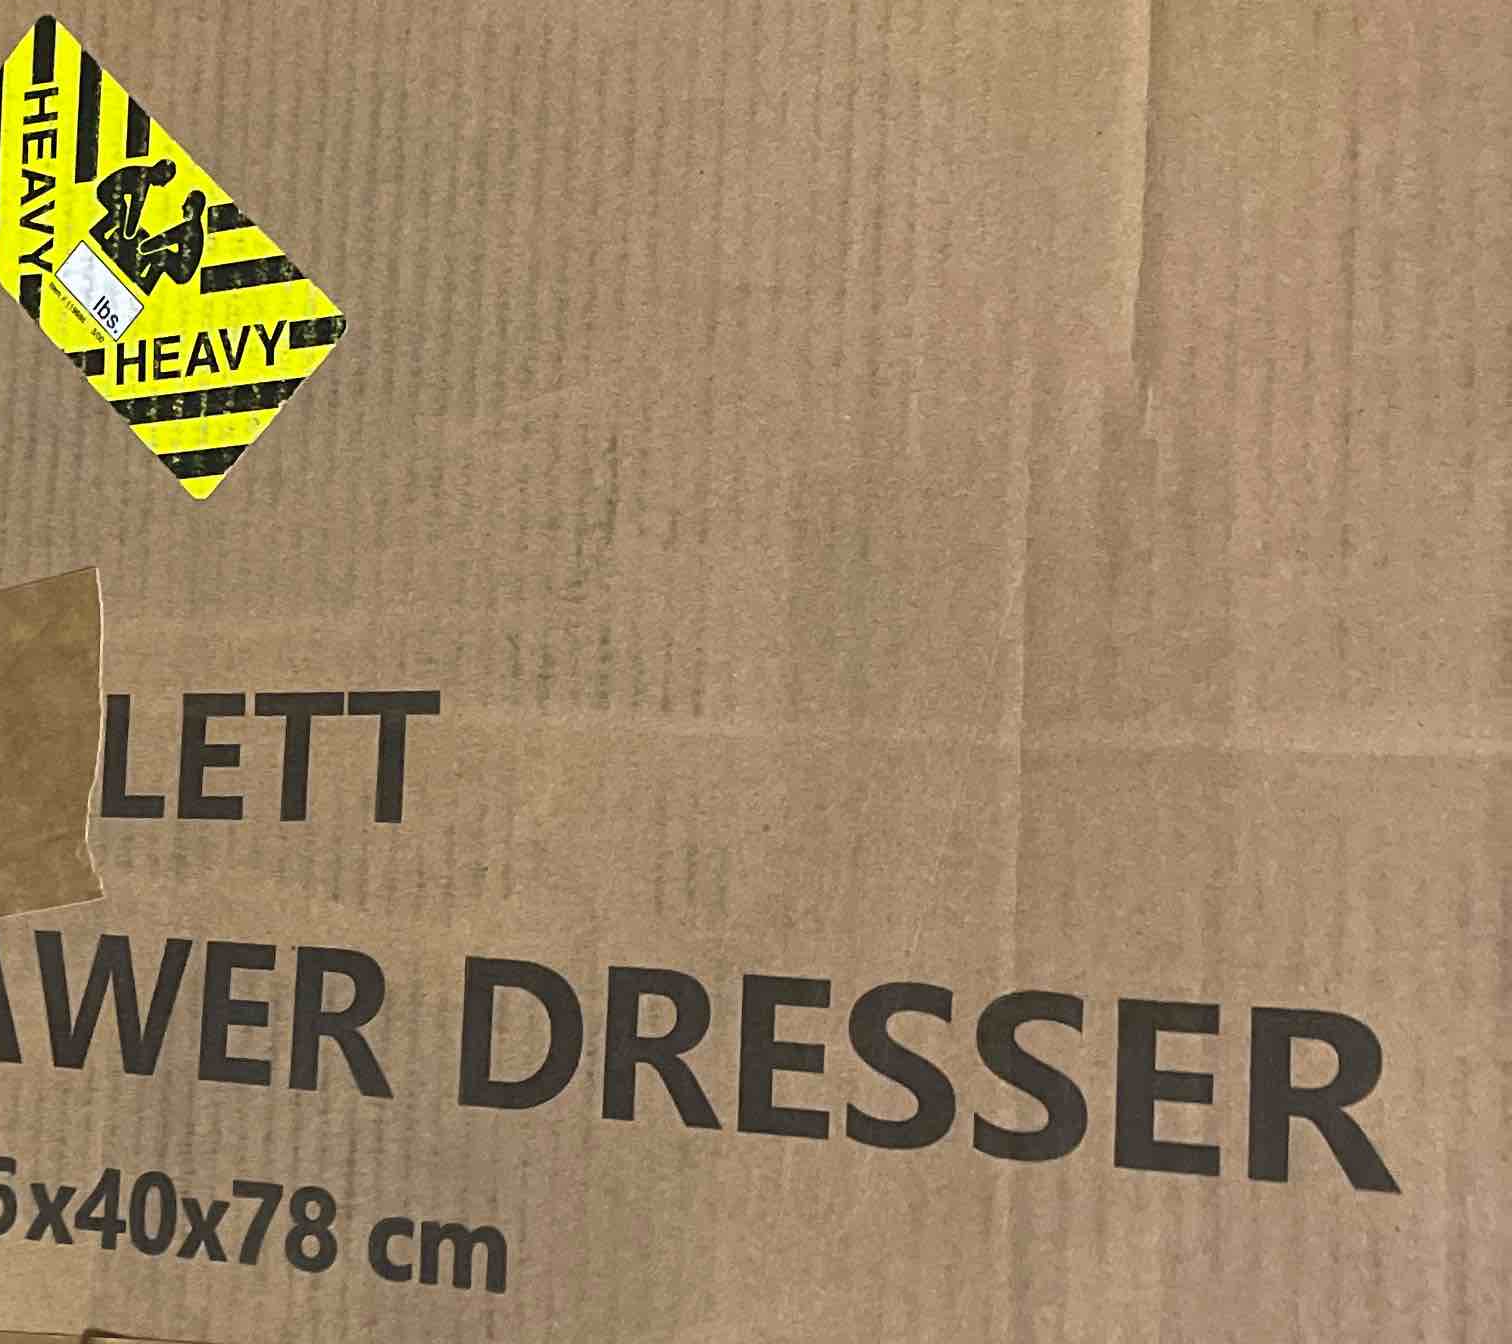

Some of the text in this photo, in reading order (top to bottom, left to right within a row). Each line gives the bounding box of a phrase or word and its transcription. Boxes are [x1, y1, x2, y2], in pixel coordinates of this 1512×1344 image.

[18, 87, 58, 273] HEAVY
[92, 295, 120, 334] lbs.
[116, 319, 288, 385] HEAVY
[458, 956, 1401, 1193] DRESSER
[368, 1216, 508, 1294] cm
